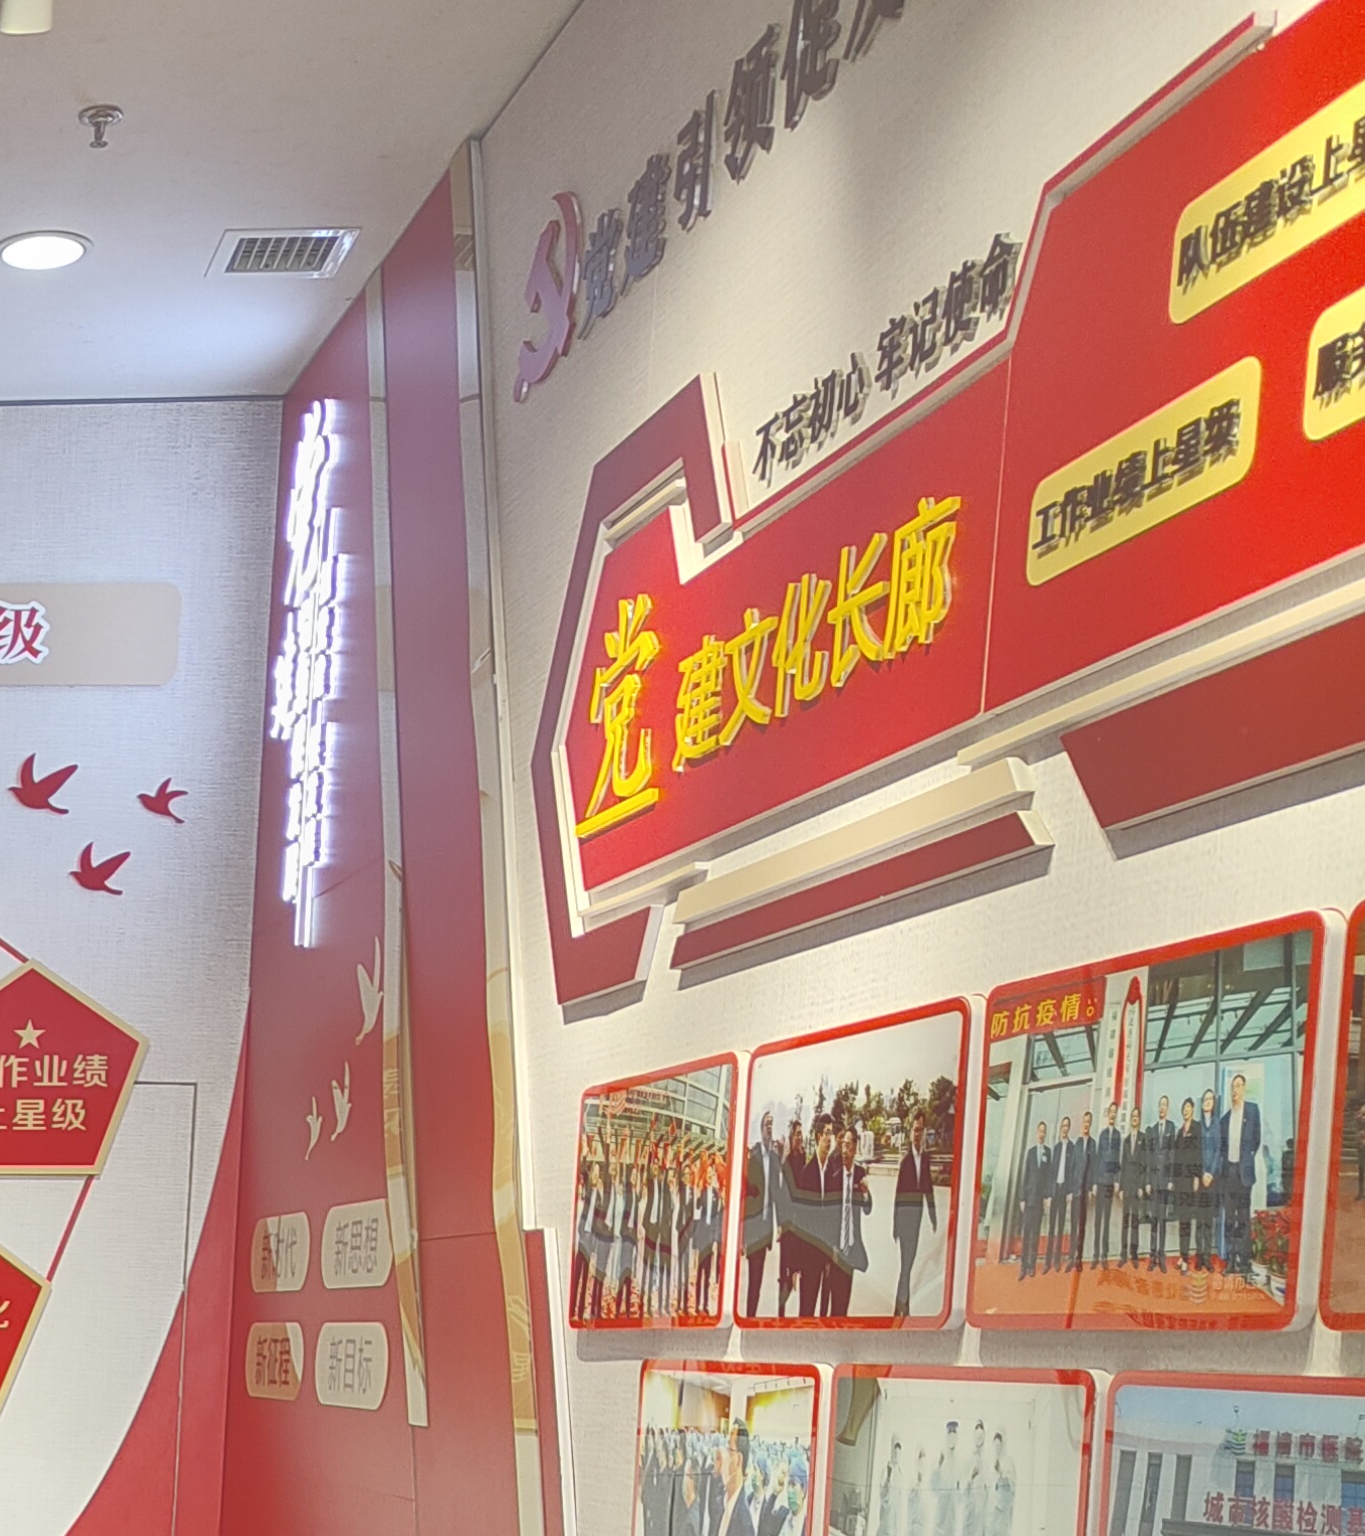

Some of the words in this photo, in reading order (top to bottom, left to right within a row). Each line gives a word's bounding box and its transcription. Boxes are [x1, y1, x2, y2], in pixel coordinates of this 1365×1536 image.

[577, 0, 905, 339] 党建引领健
[752, 352, 870, 485] 不忘初心
[875, 232, 1021, 396] 牢记使命
[1032, 399, 1240, 555] 工作业绩上星级
